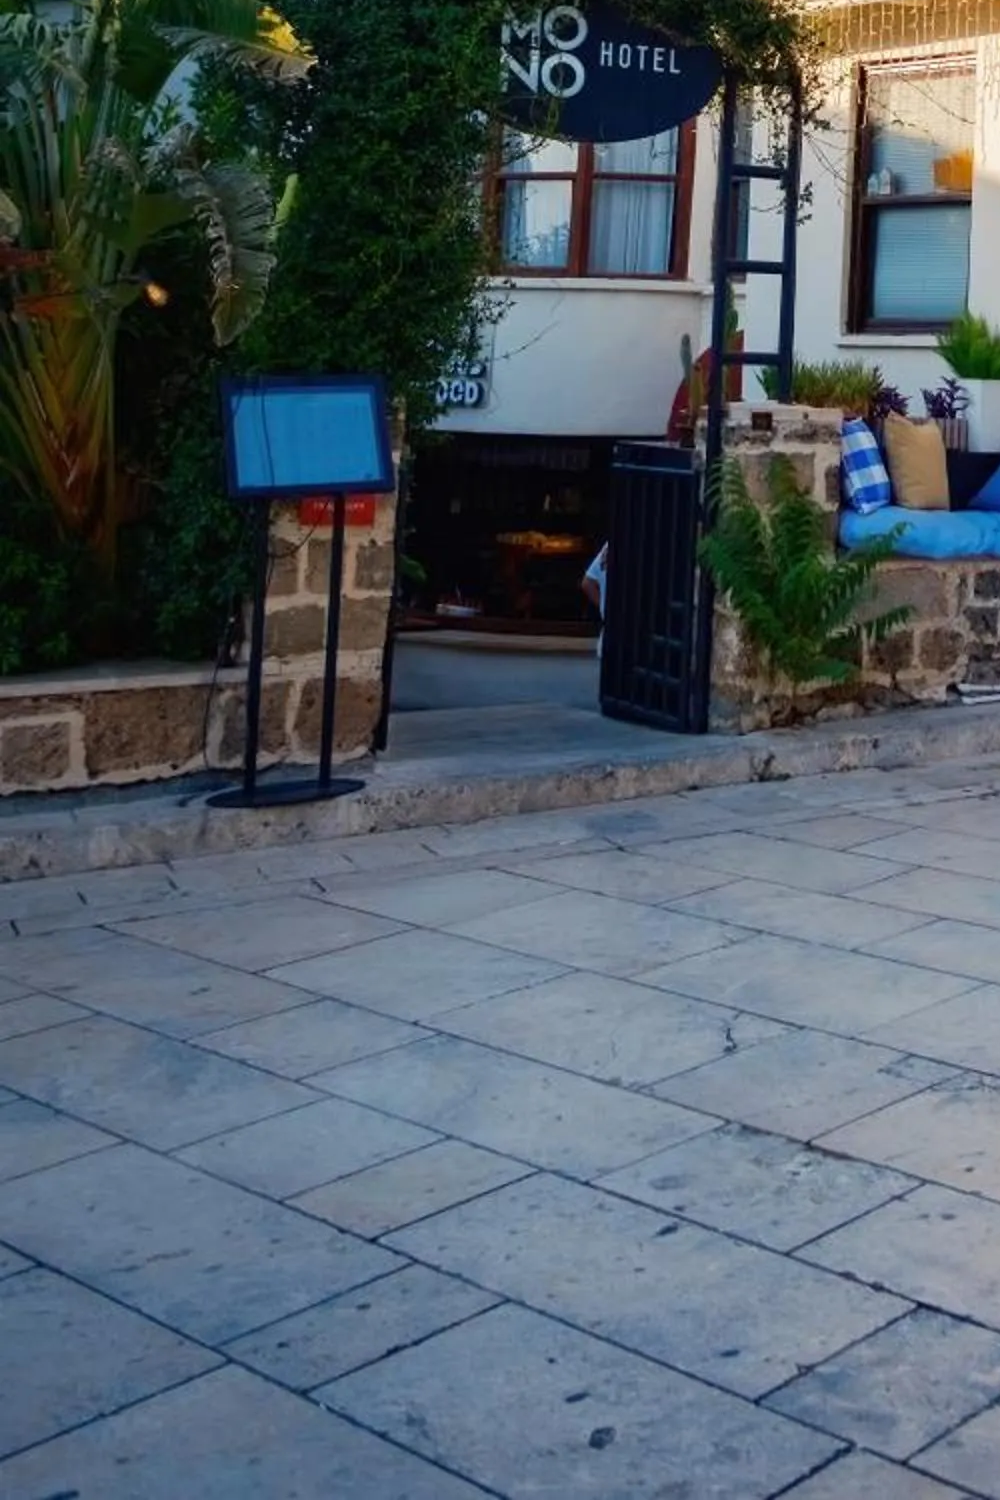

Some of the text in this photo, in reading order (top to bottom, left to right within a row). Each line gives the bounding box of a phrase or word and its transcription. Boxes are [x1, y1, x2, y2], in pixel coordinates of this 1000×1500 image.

[500, 5, 588, 50] MO
[500, 47, 585, 98] NO
[600, 41, 681, 75] HOTEL
